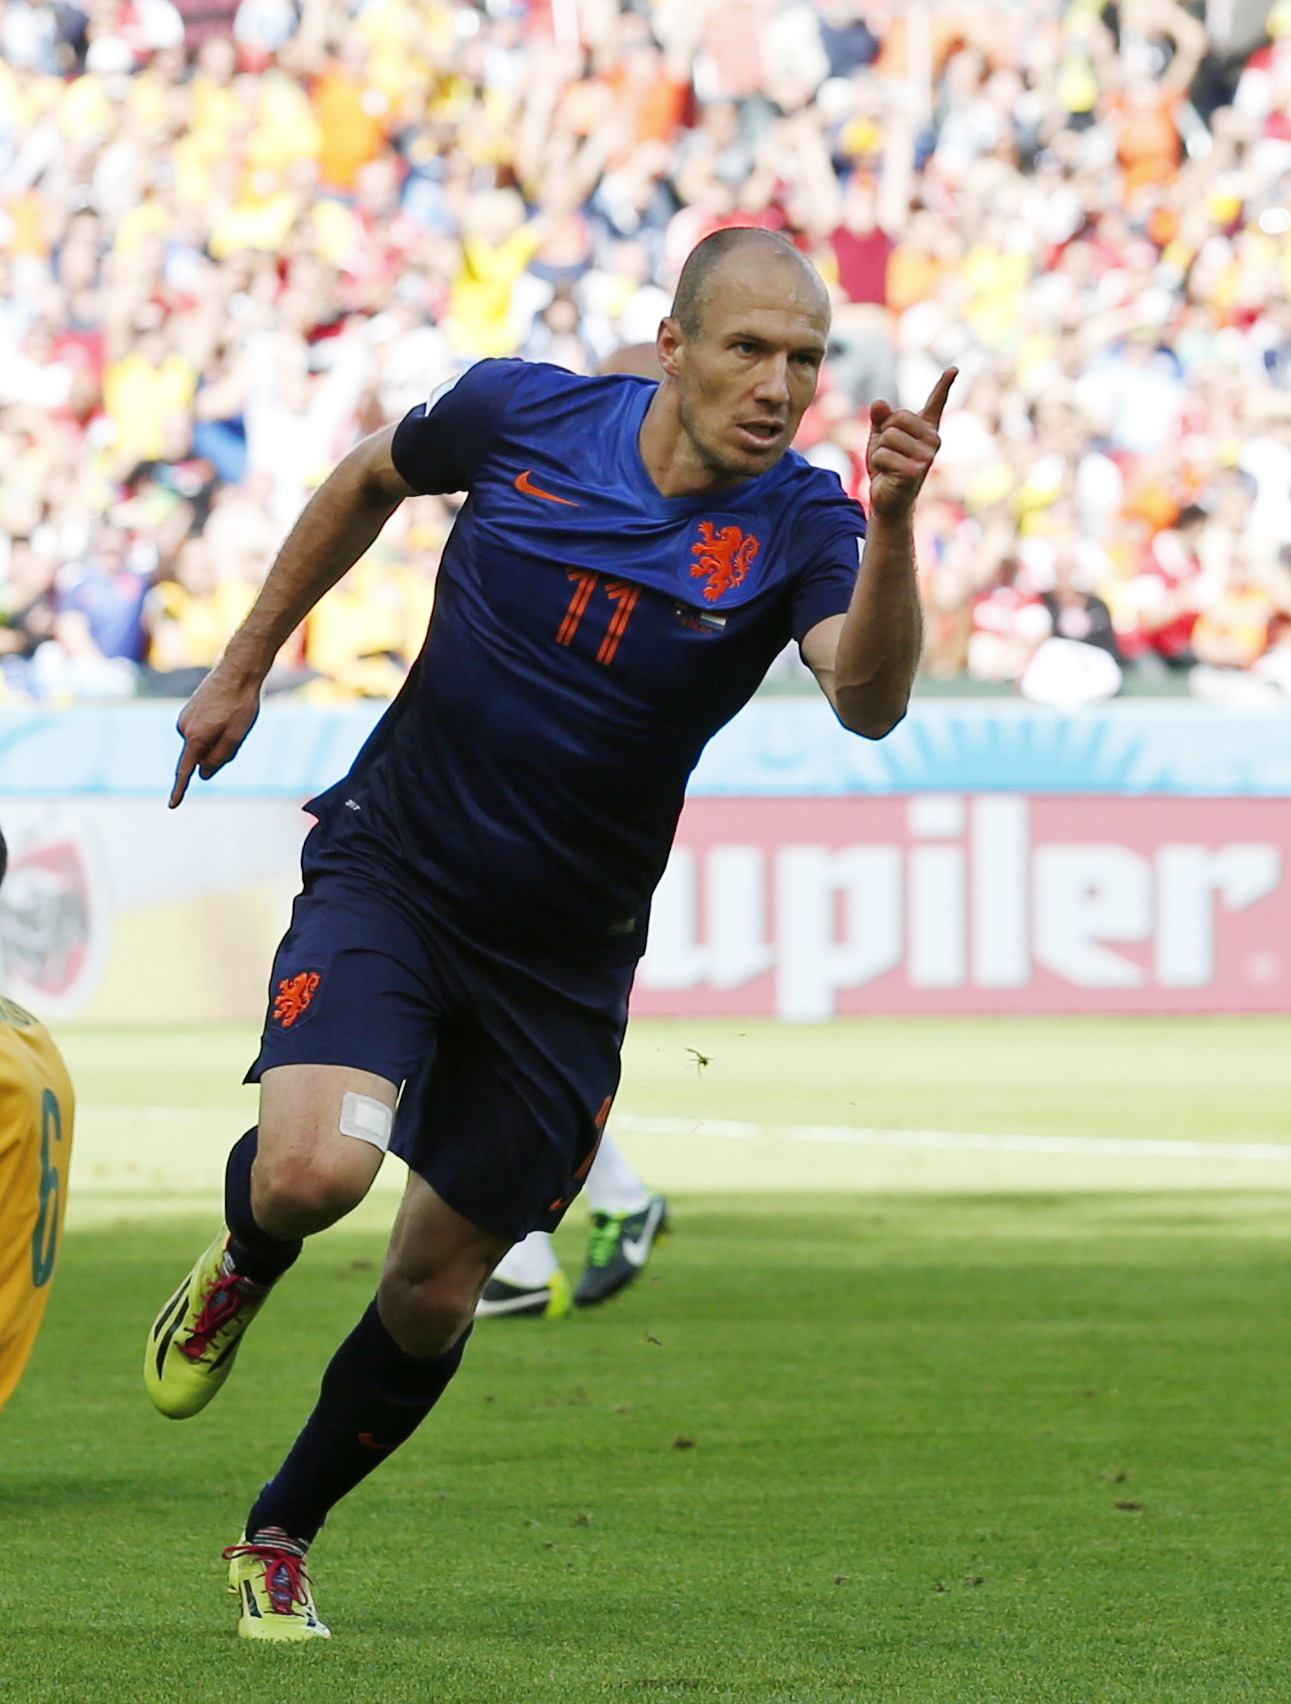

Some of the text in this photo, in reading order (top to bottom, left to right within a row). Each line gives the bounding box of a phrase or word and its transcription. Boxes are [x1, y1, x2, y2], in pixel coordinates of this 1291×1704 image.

[554, 567, 642, 666] 11
[636, 795, 1282, 1024] upiler
[32, 1088, 62, 1287] 6
